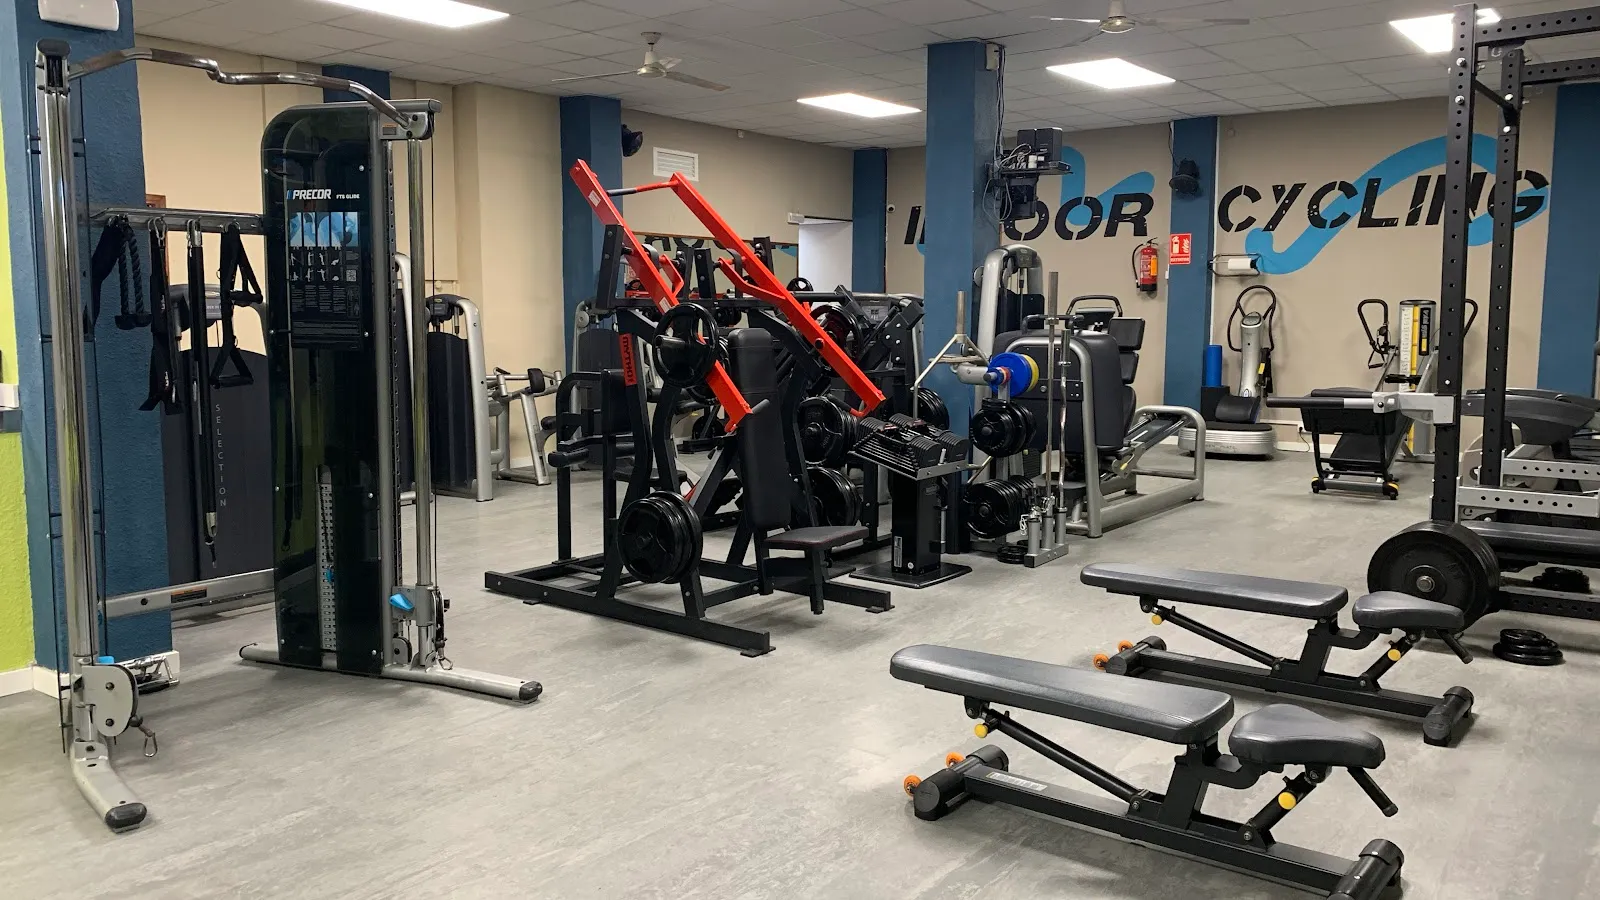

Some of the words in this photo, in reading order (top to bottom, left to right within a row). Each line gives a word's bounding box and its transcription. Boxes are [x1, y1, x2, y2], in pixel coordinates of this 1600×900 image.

[293, 189, 331, 200] PRECOR
[904, 192, 1154, 244] IOOR
[1218, 169, 1550, 233] CYCLING
[215, 404, 227, 506] SELECTION
